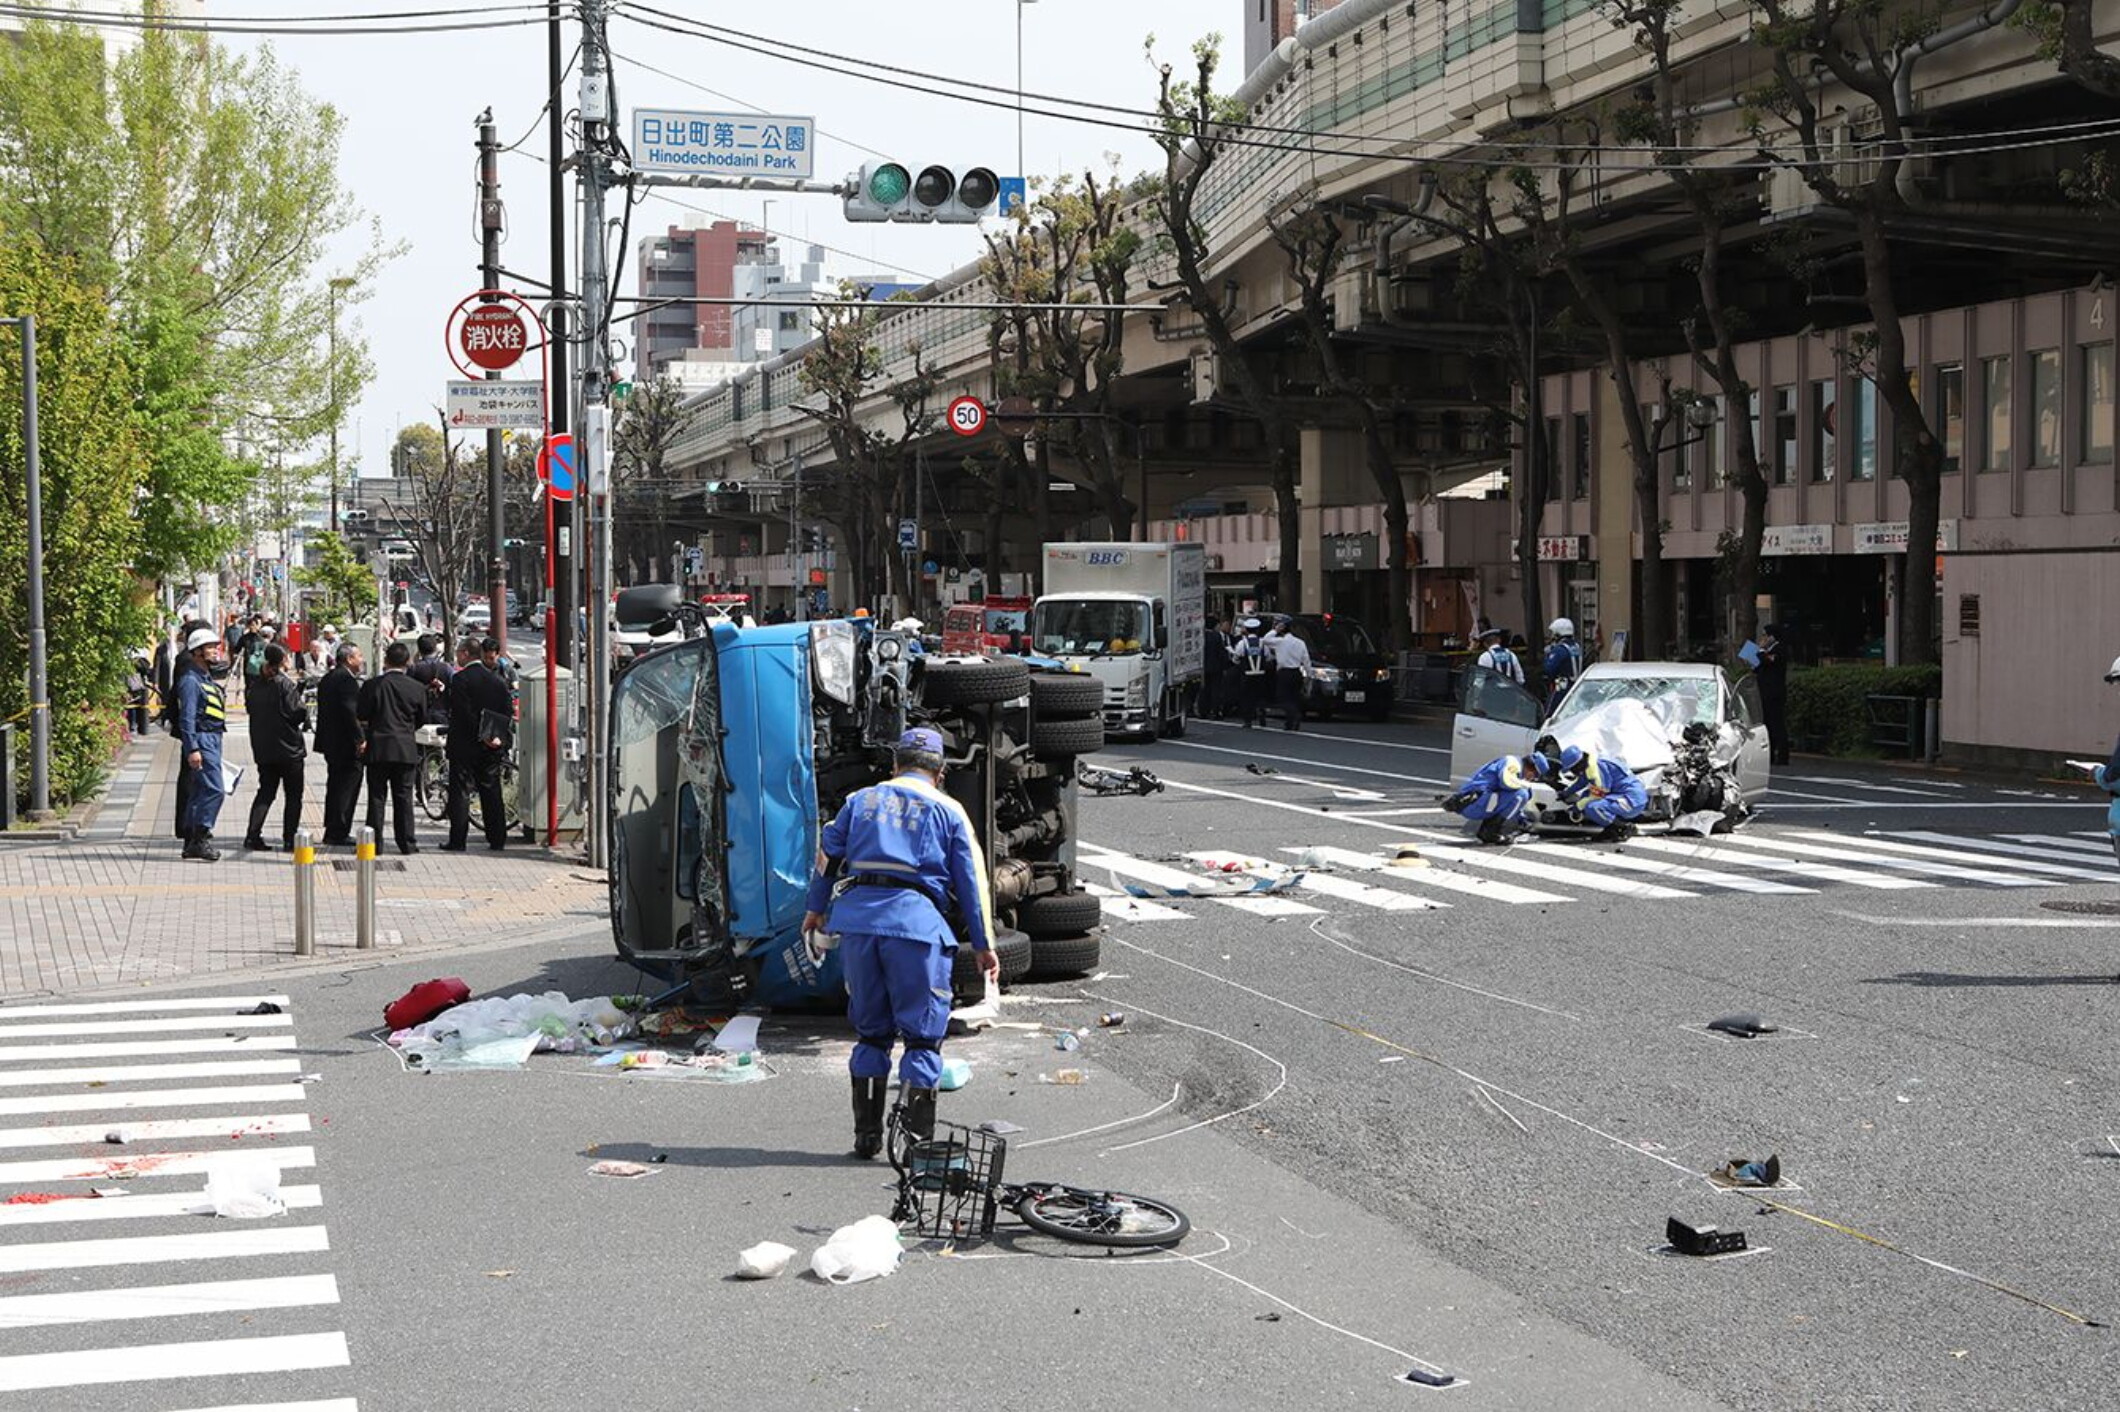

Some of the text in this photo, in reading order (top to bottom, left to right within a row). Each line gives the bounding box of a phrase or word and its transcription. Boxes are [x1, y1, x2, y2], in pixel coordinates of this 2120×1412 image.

[642, 118, 806, 152] 日出町第二公園
[650, 149, 797, 170] Hinodechodaini Park
[2090, 298, 2104, 329] 4
[466, 323, 523, 351] 消火栓
[479, 399, 539, 410] 池袋キャンパス
[956, 406, 979, 425] 50
[1088, 551, 1124, 566] BBC
